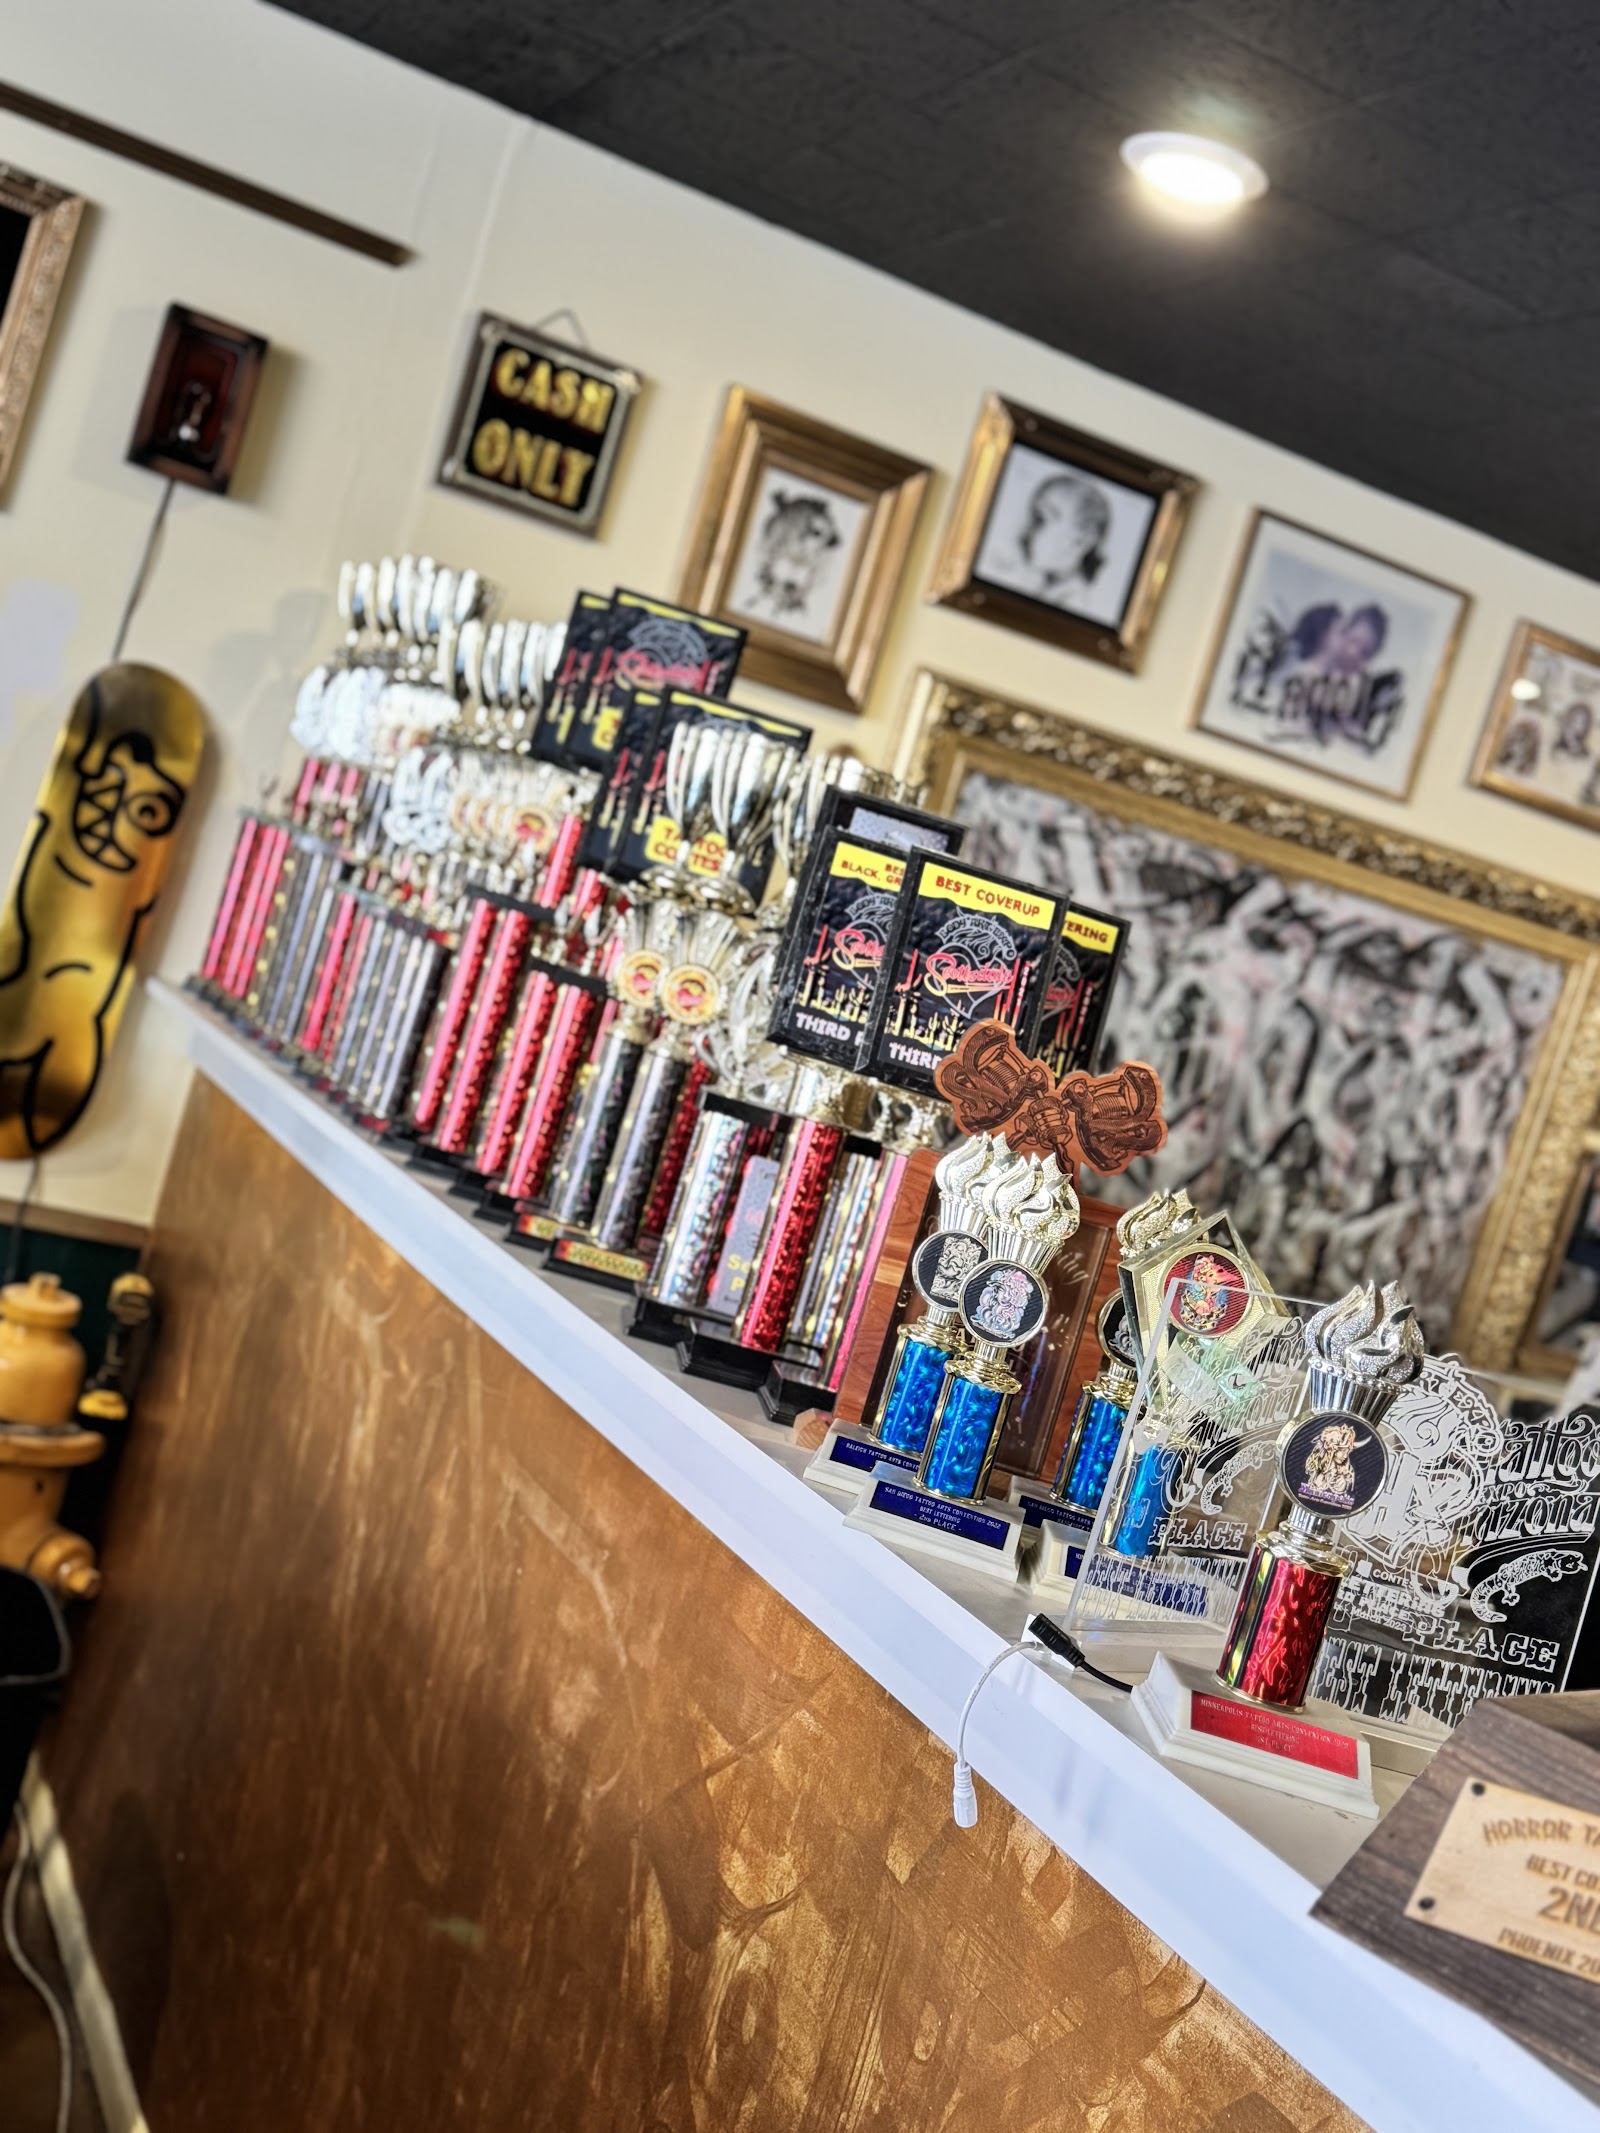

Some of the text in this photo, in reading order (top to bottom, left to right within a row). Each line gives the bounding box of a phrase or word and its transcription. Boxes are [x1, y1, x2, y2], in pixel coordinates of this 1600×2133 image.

[472, 418, 595, 507] ONLY
[936, 876, 1040, 917] BEST COVERUP
[940, 920, 967, 939] BODY
[1064, 920, 1108, 944] ERING
[924, 953, 1013, 997] Scottsdale
[796, 1012, 851, 1041] THIRD
[845, 1443, 867, 1453] RALEIGH
[868, 1449, 888, 1460] TATTOO
[888, 1456, 901, 1465] ARTS
[885, 1487, 896, 1495] SAN
[897, 1491, 913, 1500] DIEGO
[915, 1495, 936, 1507] TATTOO
[937, 1504, 951, 1512] ARTS
[952, 1508, 986, 1524] CONVENTION
[919, 1506, 961, 1524] BEST LETTERING
[1056, 1510, 1076, 1520] TATTOO
[933, 1518, 957, 1531] PLACE
[1148, 1516, 1248, 1551] PLACE
[1373, 1568, 1423, 1590] CONTEST
[1383, 1617, 1408, 1632] 2023
[1402, 1616, 1561, 1673] PLACE
[1201, 1699, 1243, 1717] MINNEAPOLIS
[1245, 1712, 1270, 1725] TATTOO
[1272, 1719, 1290, 1731] ARTS
[1482, 1816, 1573, 1847] HORROR
[1526, 1854, 1574, 1882] BEST
[1498, 1926, 1577, 1966] PHOENIX
